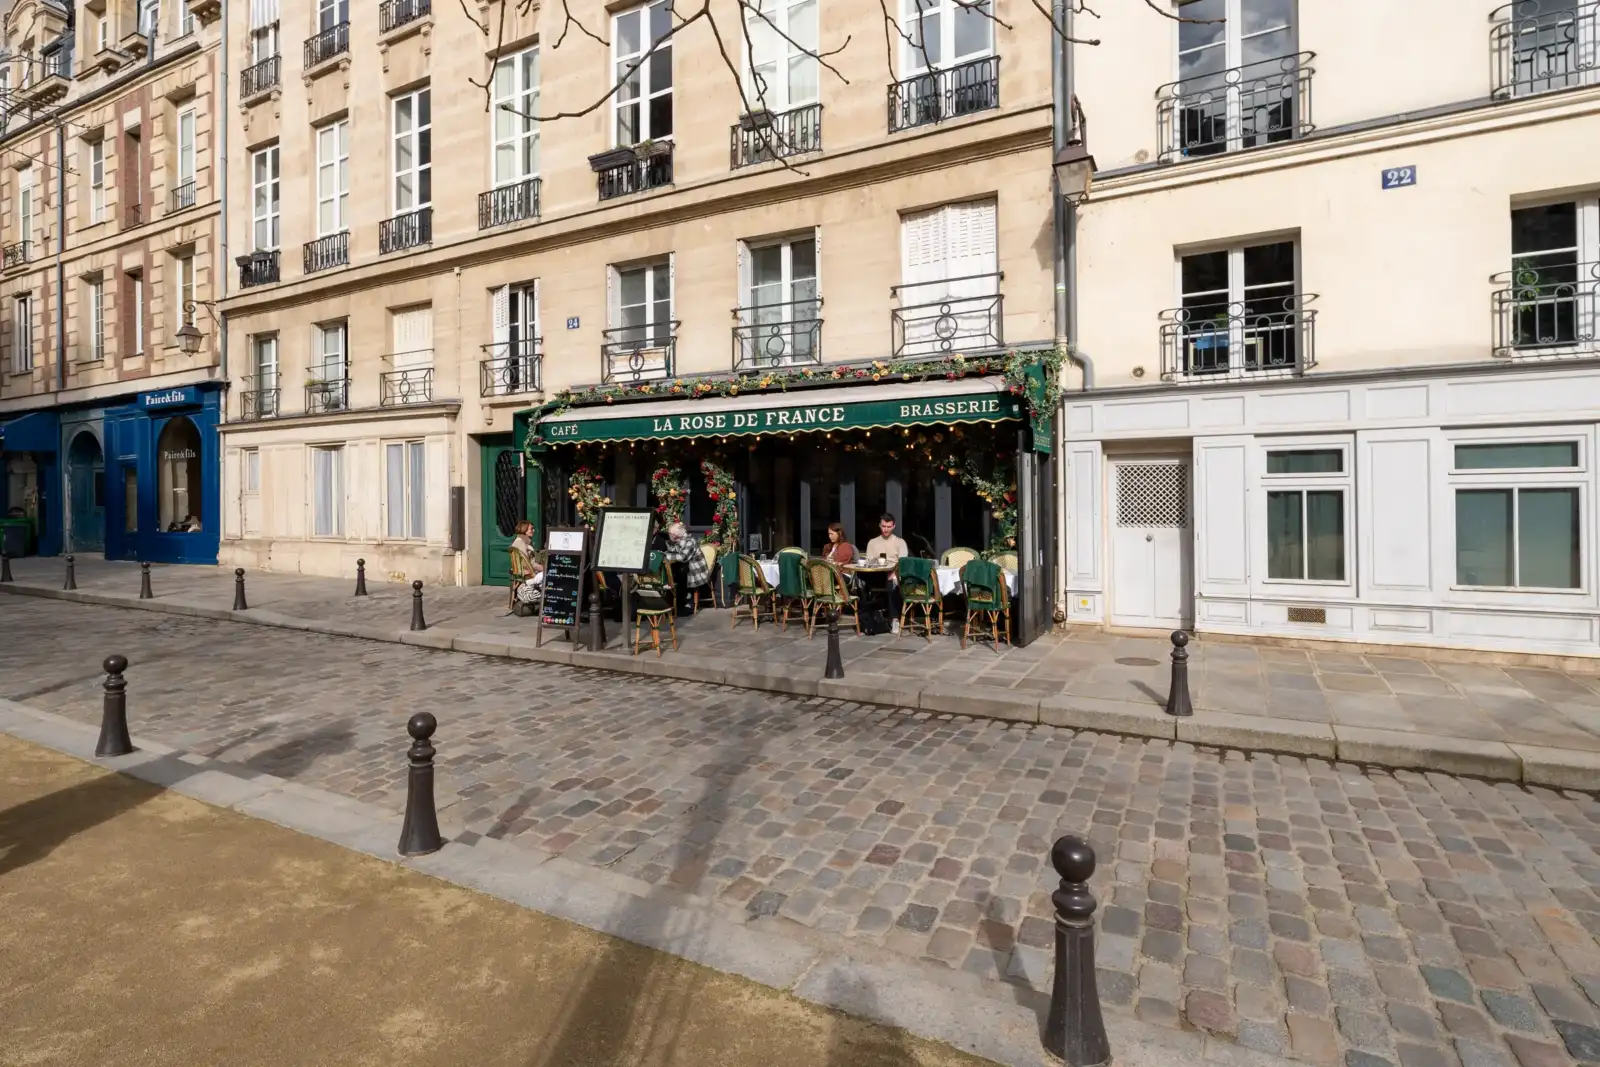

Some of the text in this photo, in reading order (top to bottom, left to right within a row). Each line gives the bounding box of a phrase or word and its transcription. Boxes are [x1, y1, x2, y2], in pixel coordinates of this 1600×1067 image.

[1387, 168, 1412, 187] 22
[568, 318, 578, 329] 24
[900, 399, 1001, 418] BRASSERIE
[653, 407, 845, 432] LA ROSE DE FRANCE
[551, 424, 579, 436] CAFÉ
